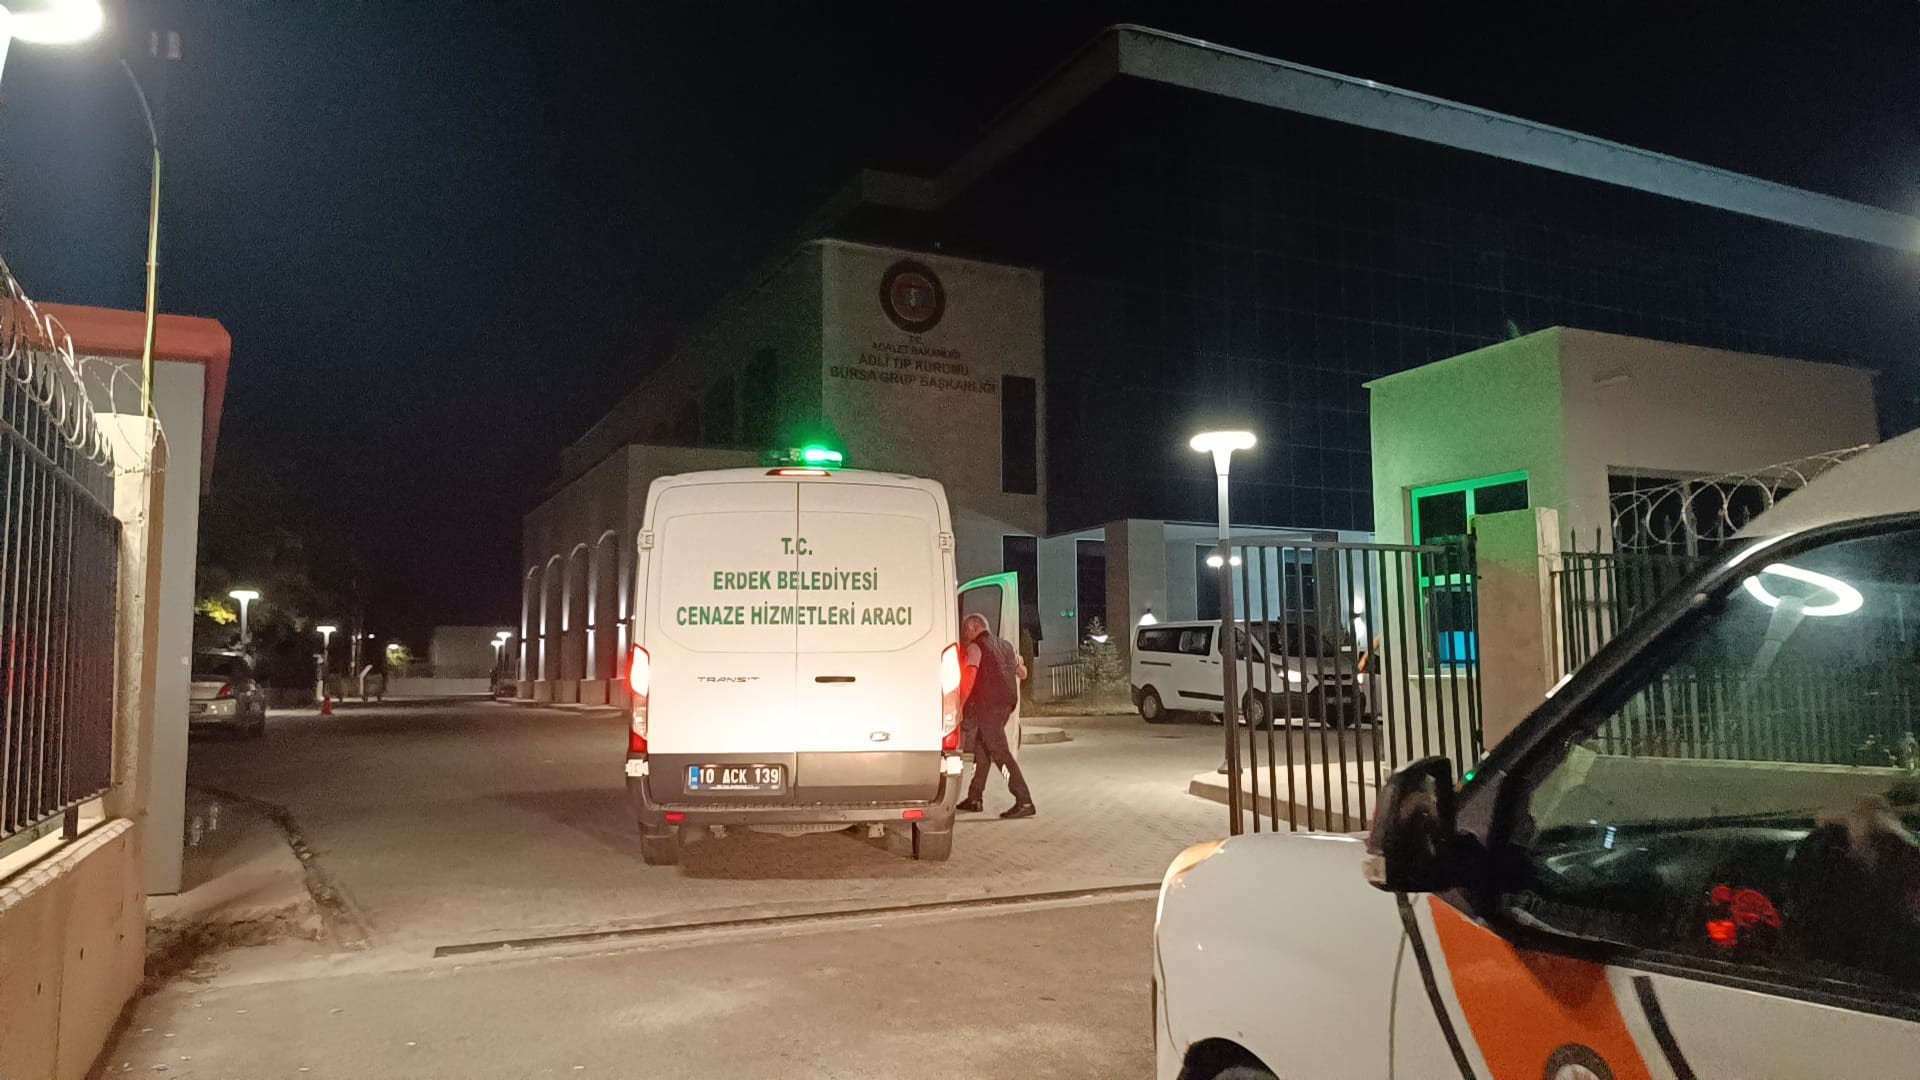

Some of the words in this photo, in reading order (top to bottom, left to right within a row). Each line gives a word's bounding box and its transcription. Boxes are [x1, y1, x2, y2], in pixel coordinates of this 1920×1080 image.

[830, 366, 877, 382] BURSA
[879, 372, 915, 385] GRUP
[893, 357, 912, 370] TIP
[916, 360, 969, 376] KURUMU
[781, 537, 813, 556] T.C.
[713, 570, 772, 590] ERDEK
[777, 567, 878, 591] BELEDİYESİ
[676, 606, 745, 626] CENAZE
[751, 601, 855, 625] HİZMETLERİ
[860, 605, 912, 625] ARACI
[697, 675, 760, 683] TRANSIT
[699, 768, 715, 784] 10
[722, 768, 747, 784] ACK
[755, 767, 779, 784] 139
